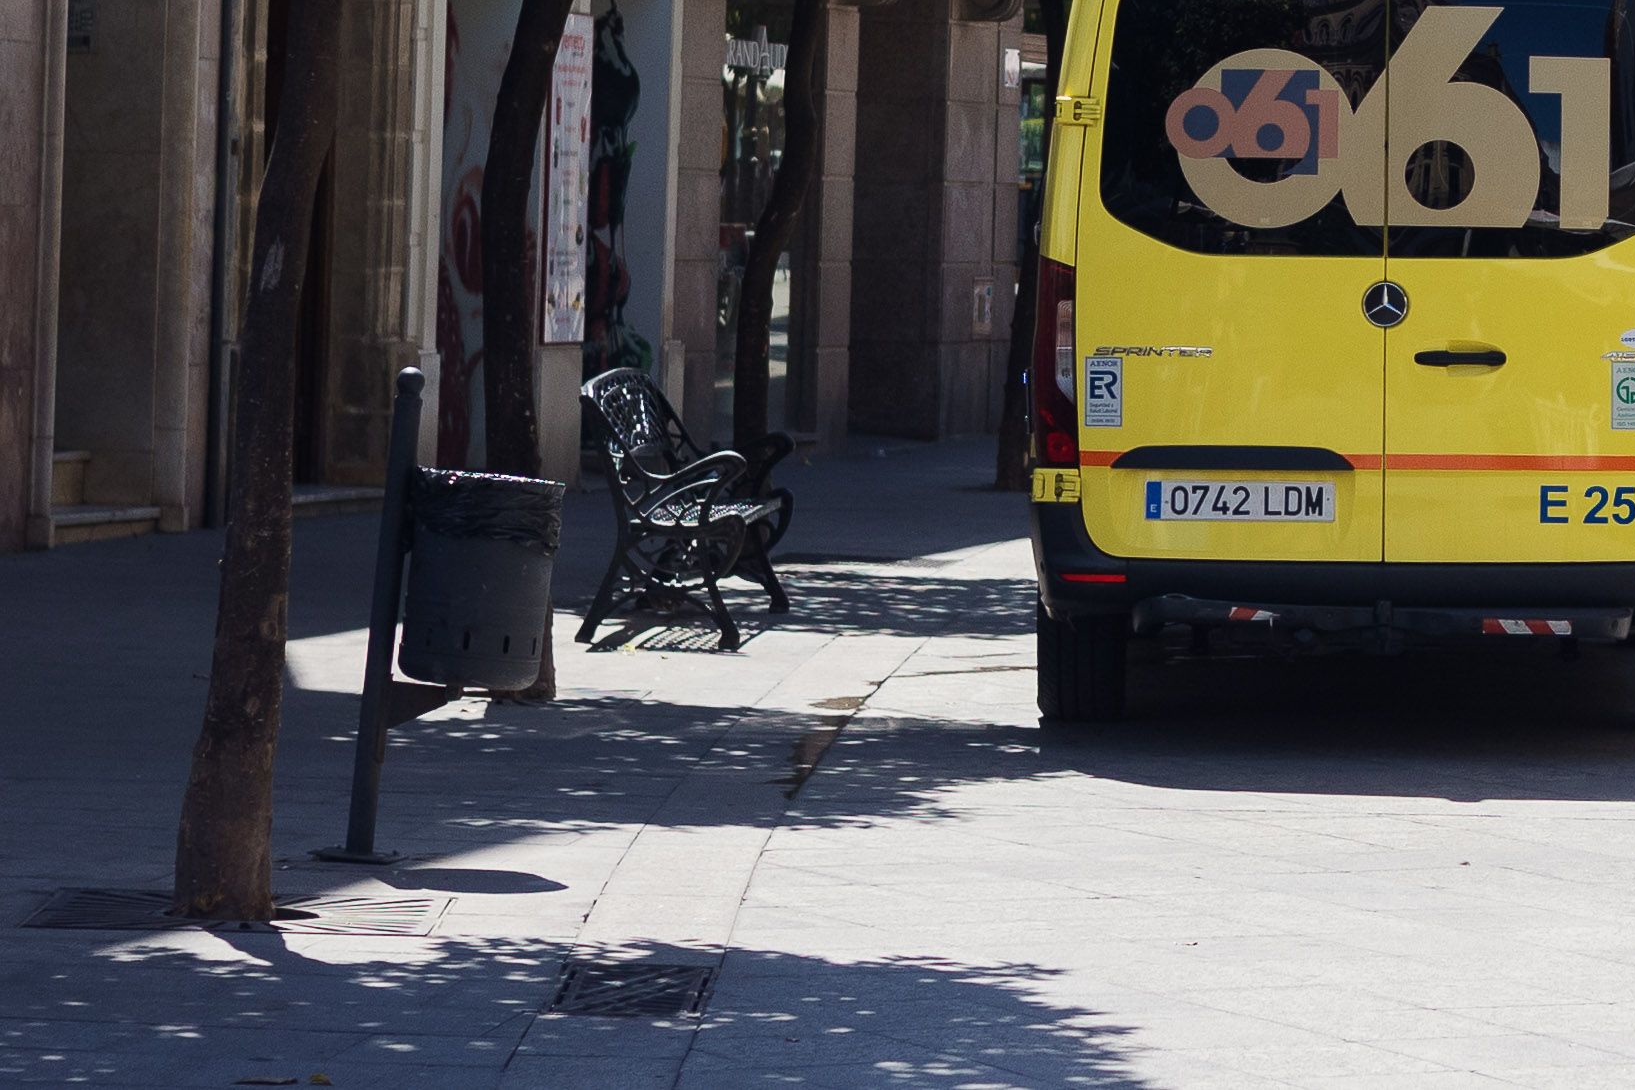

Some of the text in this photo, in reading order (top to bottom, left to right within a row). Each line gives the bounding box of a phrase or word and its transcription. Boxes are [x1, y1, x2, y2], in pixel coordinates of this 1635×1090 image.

[1165, 68, 1339, 160] 061
[1177, 5, 1611, 230] 061
[1093, 346, 1213, 358] SPRINTER
[1089, 370, 1118, 400] ER
[1149, 504, 1158, 513] E
[1170, 485, 1324, 517] 0742 LDM
[1540, 485, 1569, 524] E
